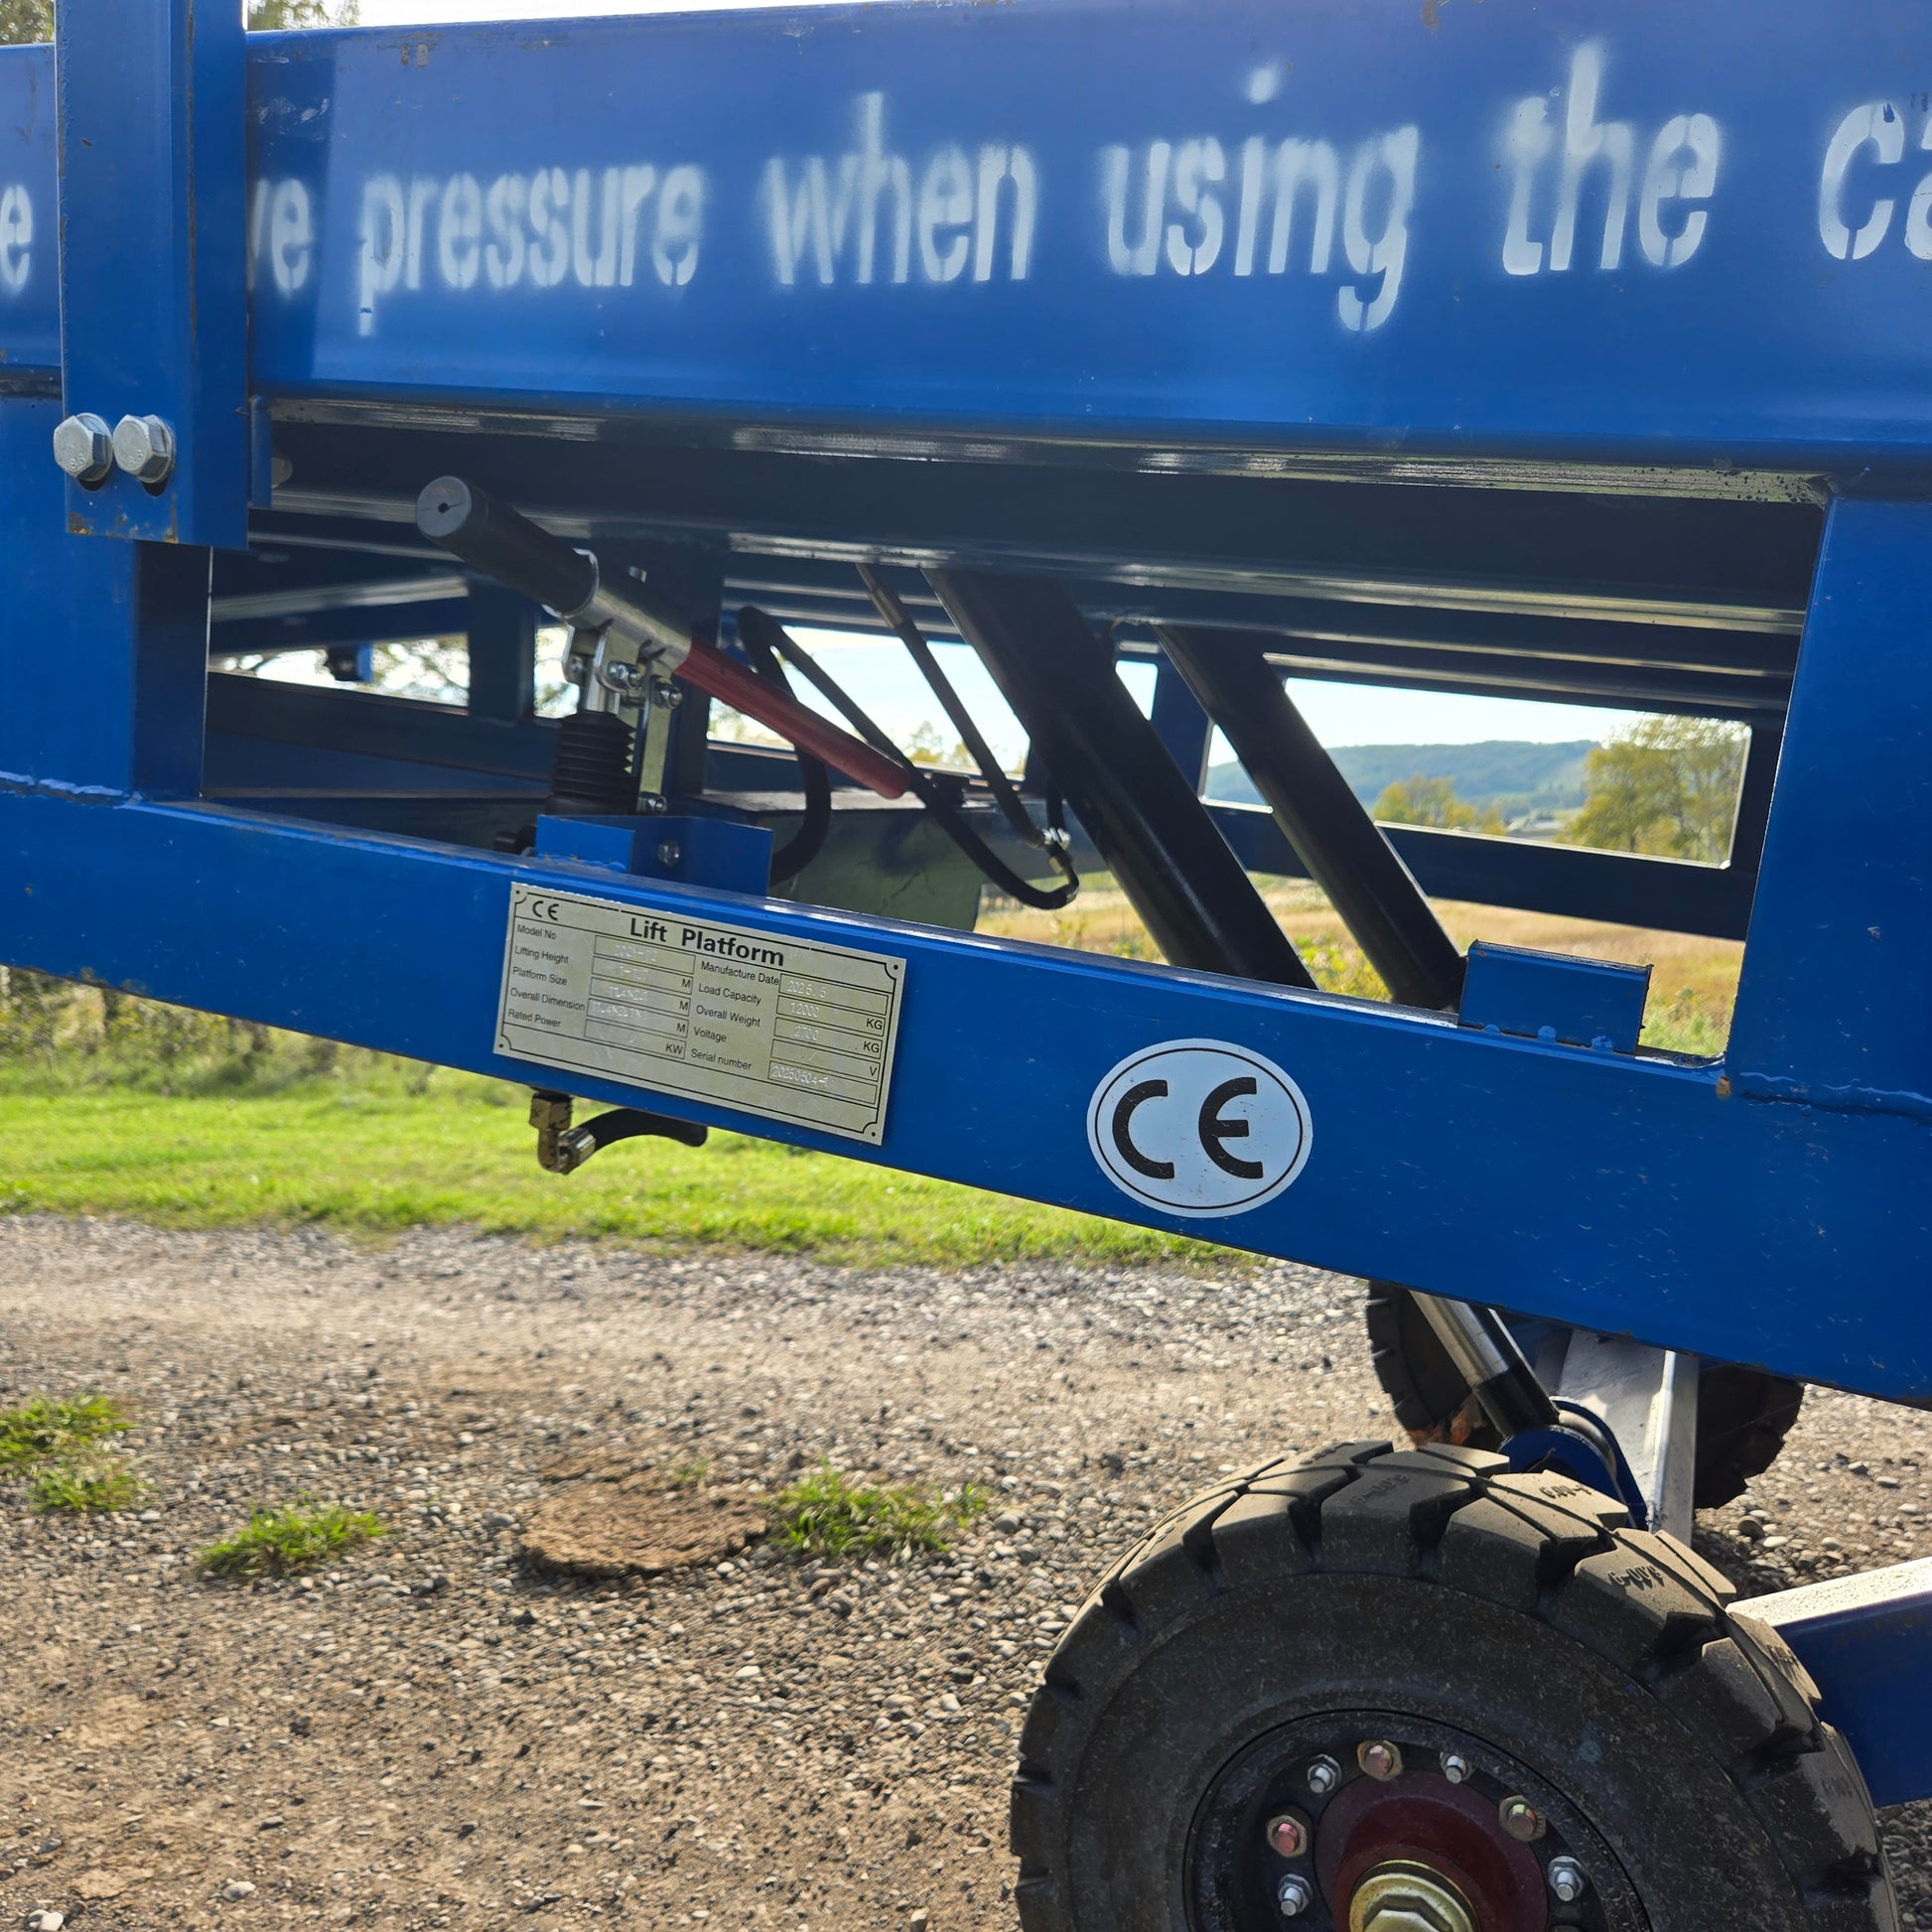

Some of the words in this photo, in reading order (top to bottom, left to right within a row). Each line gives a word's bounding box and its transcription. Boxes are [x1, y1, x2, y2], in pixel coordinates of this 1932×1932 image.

[359, 164, 704, 338] pressure
[762, 91, 1036, 285] when
[1103, 66, 1420, 332] using
[1501, 40, 1720, 276] the
[516, 923, 543, 938] Model
[544, 929, 557, 940] No
[531, 899, 560, 921] CE
[629, 917, 668, 942] Lift
[681, 928, 784, 967] Platform
[512, 966, 548, 982] Platform
[549, 974, 568, 986] Size
[679, 1000, 689, 1011] M
[514, 945, 540, 960] Lifting
[541, 950, 570, 965] Height
[681, 977, 691, 989] M
[700, 960, 757, 981] Manufacture
[758, 972, 780, 986] Date
[510, 987, 540, 1002] Overall
[541, 994, 586, 1012] Dimension
[676, 1023, 686, 1034] M
[696, 1005, 728, 1021] Overall
[730, 1013, 761, 1029] Weight
[863, 1040, 881, 1053] KG
[698, 983, 722, 997] Load
[723, 988, 762, 1008] Capacity
[866, 1018, 884, 1031] KG
[507, 1008, 533, 1023] Rated
[534, 1014, 562, 1029] Power
[665, 1043, 684, 1055] KW
[693, 1027, 728, 1043] Voltage
[869, 1065, 878, 1077] V
[690, 1047, 717, 1063] Serial
[717, 1055, 753, 1071] number
[1112, 1076, 1264, 1180] CE
